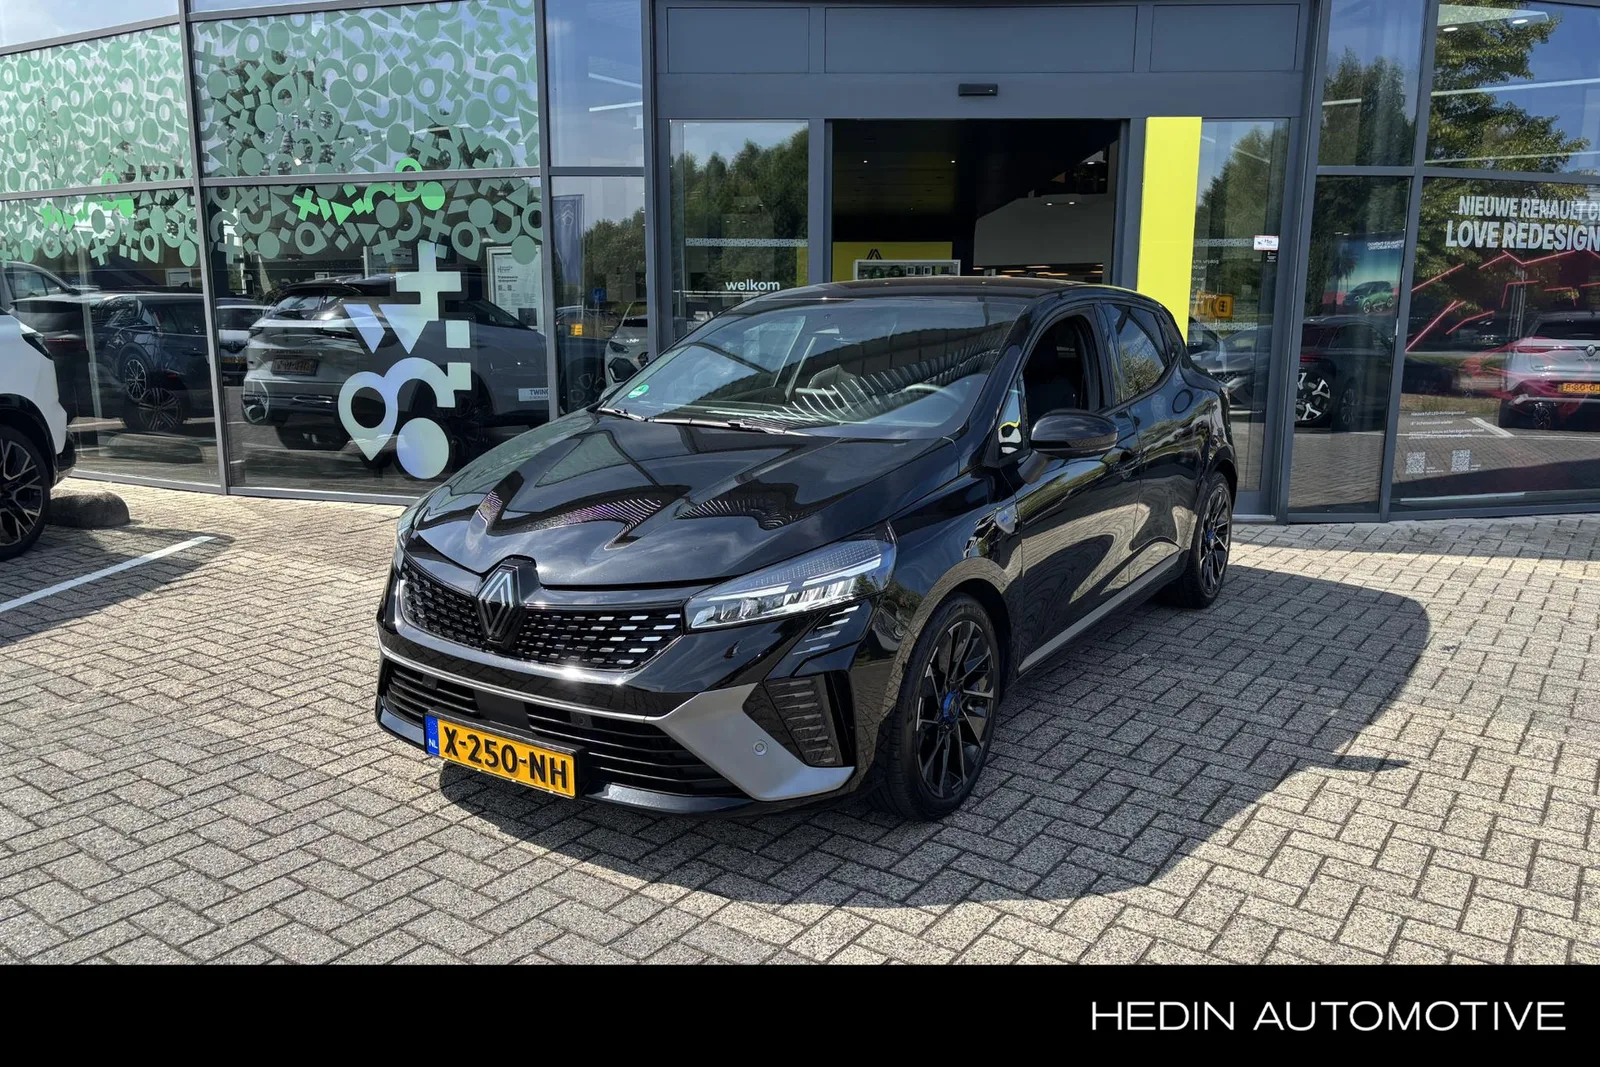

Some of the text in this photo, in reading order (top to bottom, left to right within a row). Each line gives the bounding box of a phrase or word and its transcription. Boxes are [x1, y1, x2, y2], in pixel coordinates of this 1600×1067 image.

[1519, 199, 1582, 220] RENAULT
[1446, 220, 1499, 249] LOVE
[725, 279, 780, 291] welkom
[428, 739, 438, 749] NL
[444, 726, 567, 789] X-250-NH
